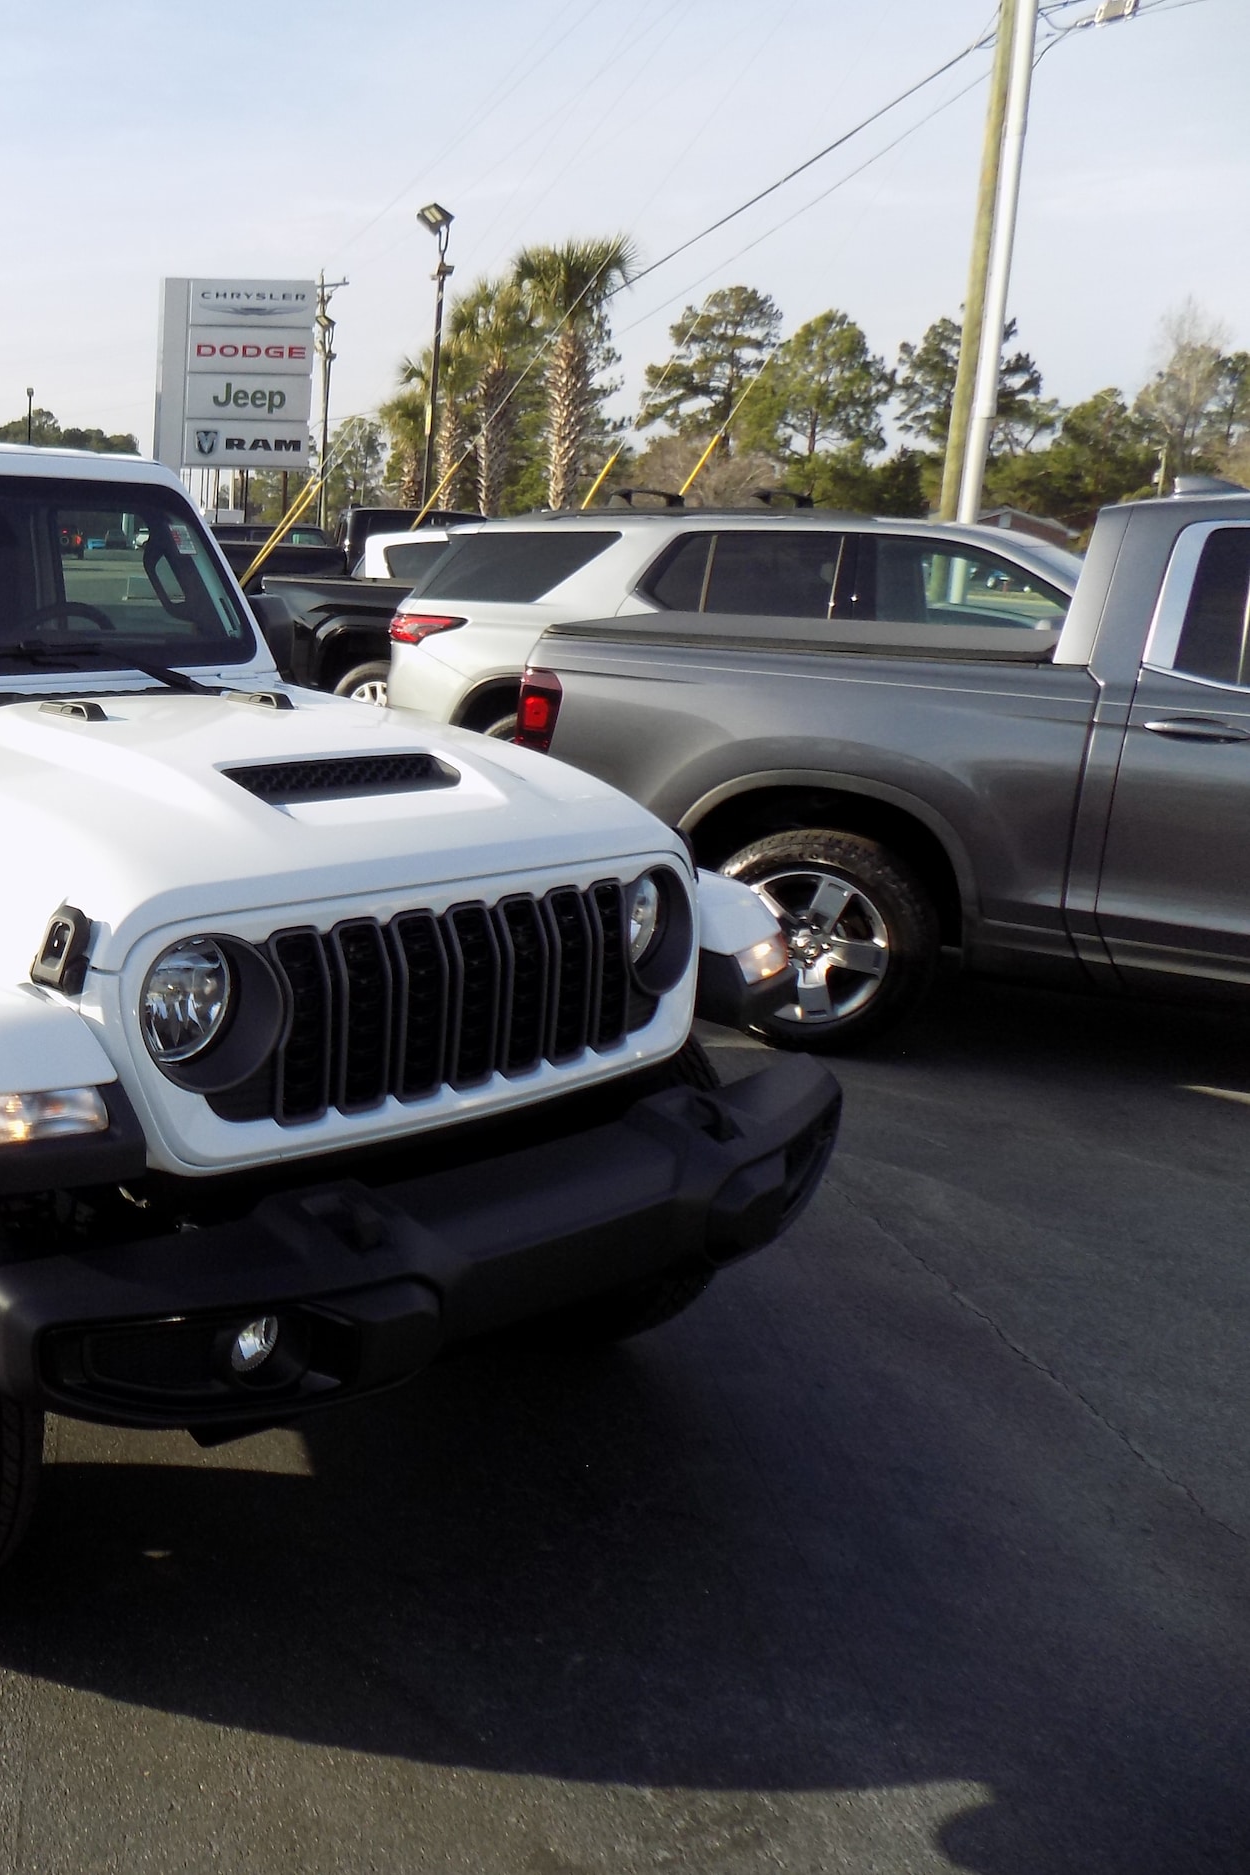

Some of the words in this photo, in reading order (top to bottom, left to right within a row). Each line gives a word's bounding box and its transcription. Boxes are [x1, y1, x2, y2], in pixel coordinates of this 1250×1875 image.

[200, 291, 306, 302] CHRYSLER
[196, 343, 307, 360] DODGE
[212, 382, 286, 413] Jeep
[225, 437, 302, 452] RAM
